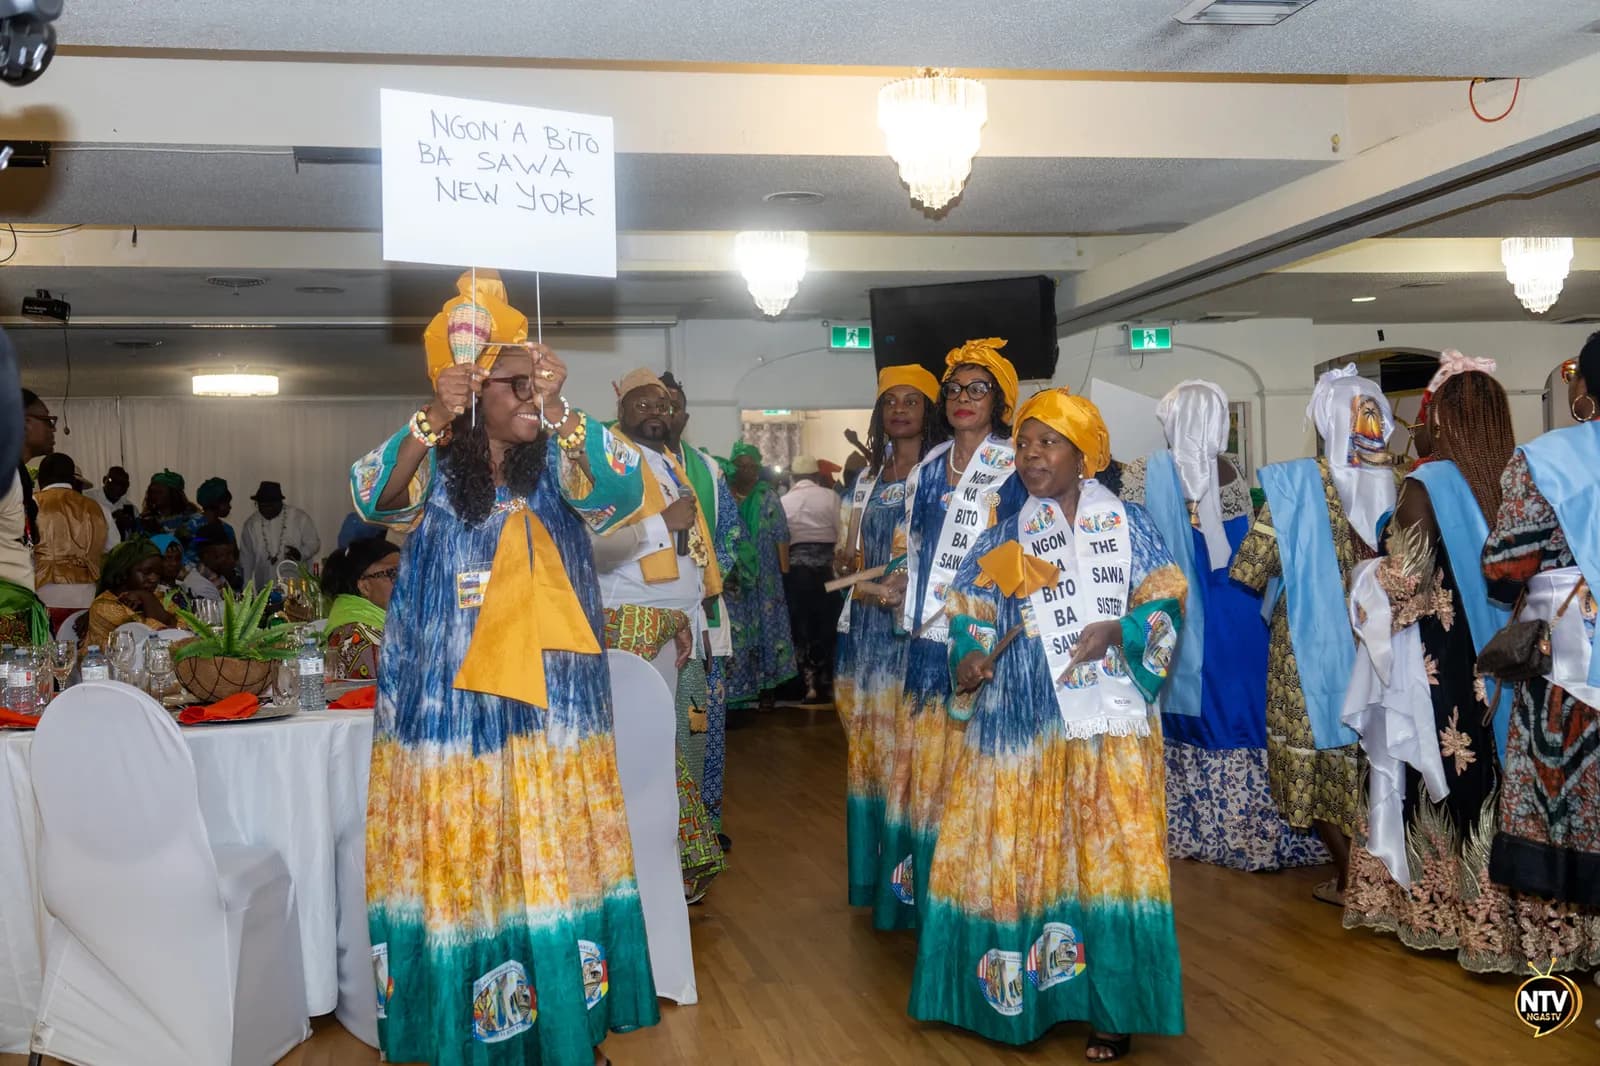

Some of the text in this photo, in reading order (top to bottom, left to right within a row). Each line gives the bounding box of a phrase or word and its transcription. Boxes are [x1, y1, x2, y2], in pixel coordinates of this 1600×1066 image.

[417, 139, 574, 178] BA SAWA
[434, 176, 595, 216] NEW YORK
[963, 487, 978, 502] NA
[955, 508, 978, 526] BITO
[951, 532, 968, 549] BA
[1031, 530, 1067, 557] NGON
[1089, 538, 1119, 555] THE
[939, 552, 963, 570] SAW
[1092, 567, 1125, 584] SAWA
[1054, 606, 1078, 627] BA
[1052, 631, 1084, 655] SAW
